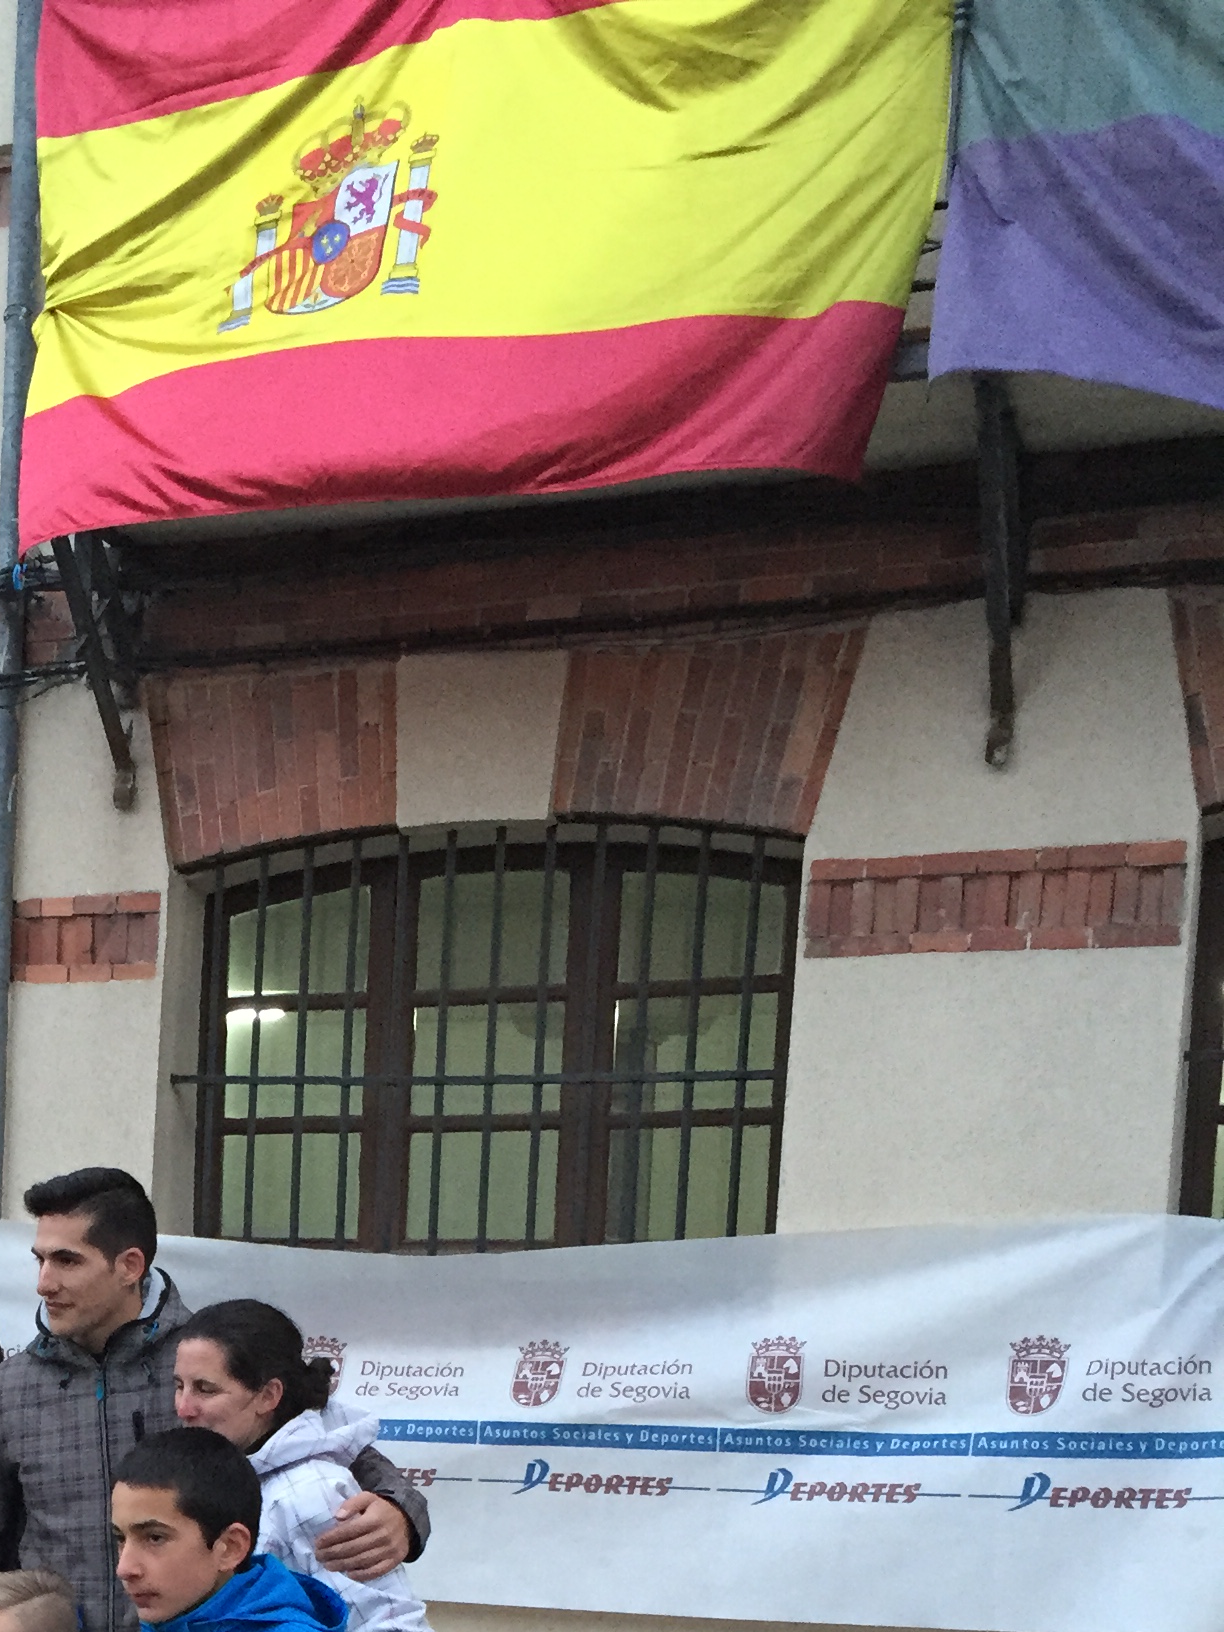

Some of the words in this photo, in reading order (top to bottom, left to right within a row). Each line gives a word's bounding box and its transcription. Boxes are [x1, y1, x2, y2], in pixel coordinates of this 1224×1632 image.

[360, 1360, 464, 1380] Diputación
[581, 1359, 693, 1380] Diputación
[823, 1359, 948, 1382] Diputación
[1085, 1354, 1213, 1380] Diputación
[355, 1382, 379, 1397] de
[384, 1382, 459, 1401] Segovia
[576, 1382, 603, 1399] de
[608, 1381, 691, 1404] Segovia
[821, 1384, 851, 1404] de
[857, 1384, 947, 1410] Segovia
[1082, 1382, 1113, 1402] de
[1121, 1382, 1213, 1409] Segovia
[394, 1425, 403, 1437] y
[406, 1423, 474, 1438] Deportes
[483, 1425, 547, 1441] Asuntos
[552, 1427, 620, 1442] Sociales
[626, 1431, 634, 1444] y
[639, 1429, 714, 1446] Deportes
[723, 1433, 792, 1447] Asuntos
[798, 1435, 870, 1450] Sociales
[876, 1439, 885, 1452] y
[889, 1438, 966, 1453] Deportes
[977, 1436, 1049, 1450] Asuntos
[1056, 1437, 1134, 1452] Sociales
[1139, 1441, 1148, 1453] y
